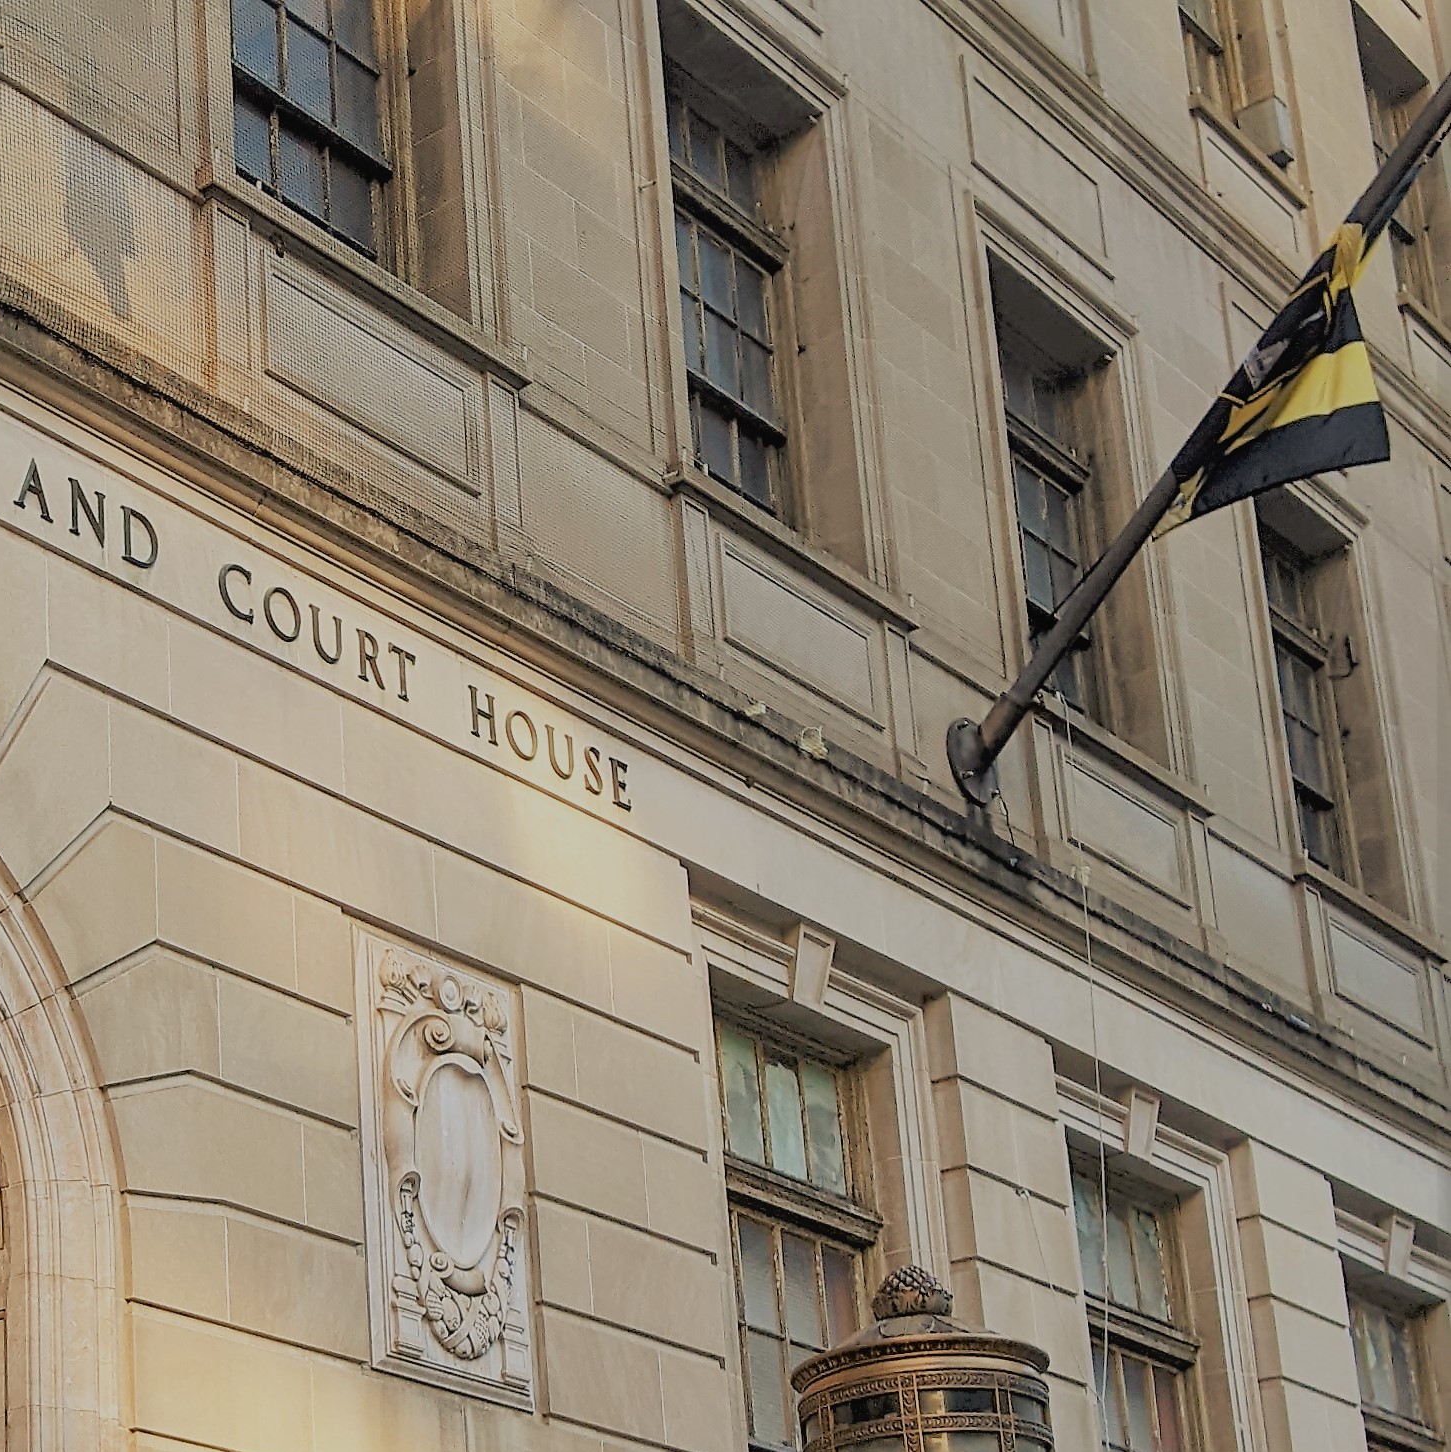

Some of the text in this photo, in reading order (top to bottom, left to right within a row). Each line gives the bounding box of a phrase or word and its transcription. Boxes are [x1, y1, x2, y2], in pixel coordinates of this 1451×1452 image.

[13, 458, 159, 569] AND
[218, 563, 416, 702] COURT
[467, 685, 632, 812] HOUSE
